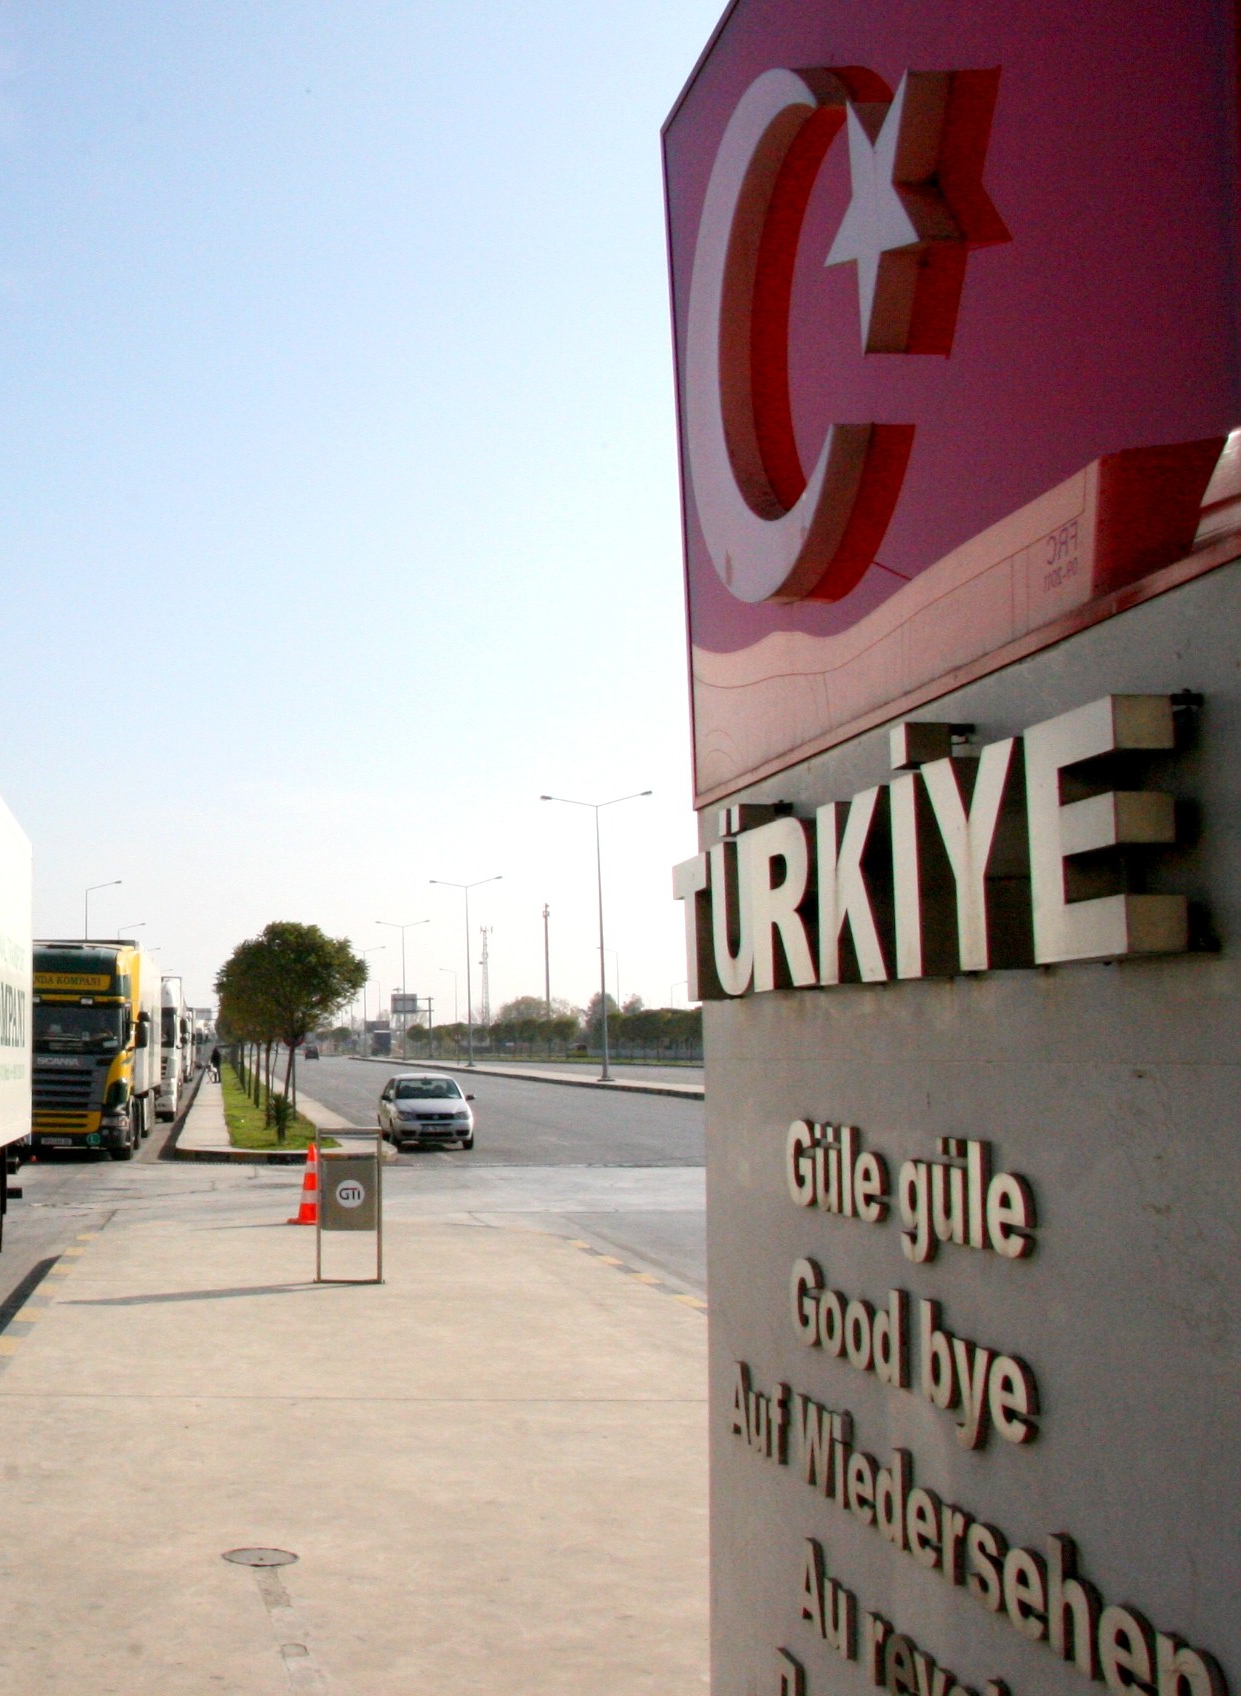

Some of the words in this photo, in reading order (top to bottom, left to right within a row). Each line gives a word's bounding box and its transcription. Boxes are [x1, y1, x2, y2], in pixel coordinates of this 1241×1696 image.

[672, 694, 1180, 1001] TÜRKİYE
[57, 975, 101, 986] KOMPANI
[37, 1057, 80, 1066] SCANIA
[786, 1119, 889, 1223] Güle
[898, 1136, 1036, 1263] güle
[733, 1361, 790, 1465] Auf
[791, 1257, 909, 1389] Good
[921, 1299, 1039, 1450] bye
[802, 1537, 858, 1660] Au
